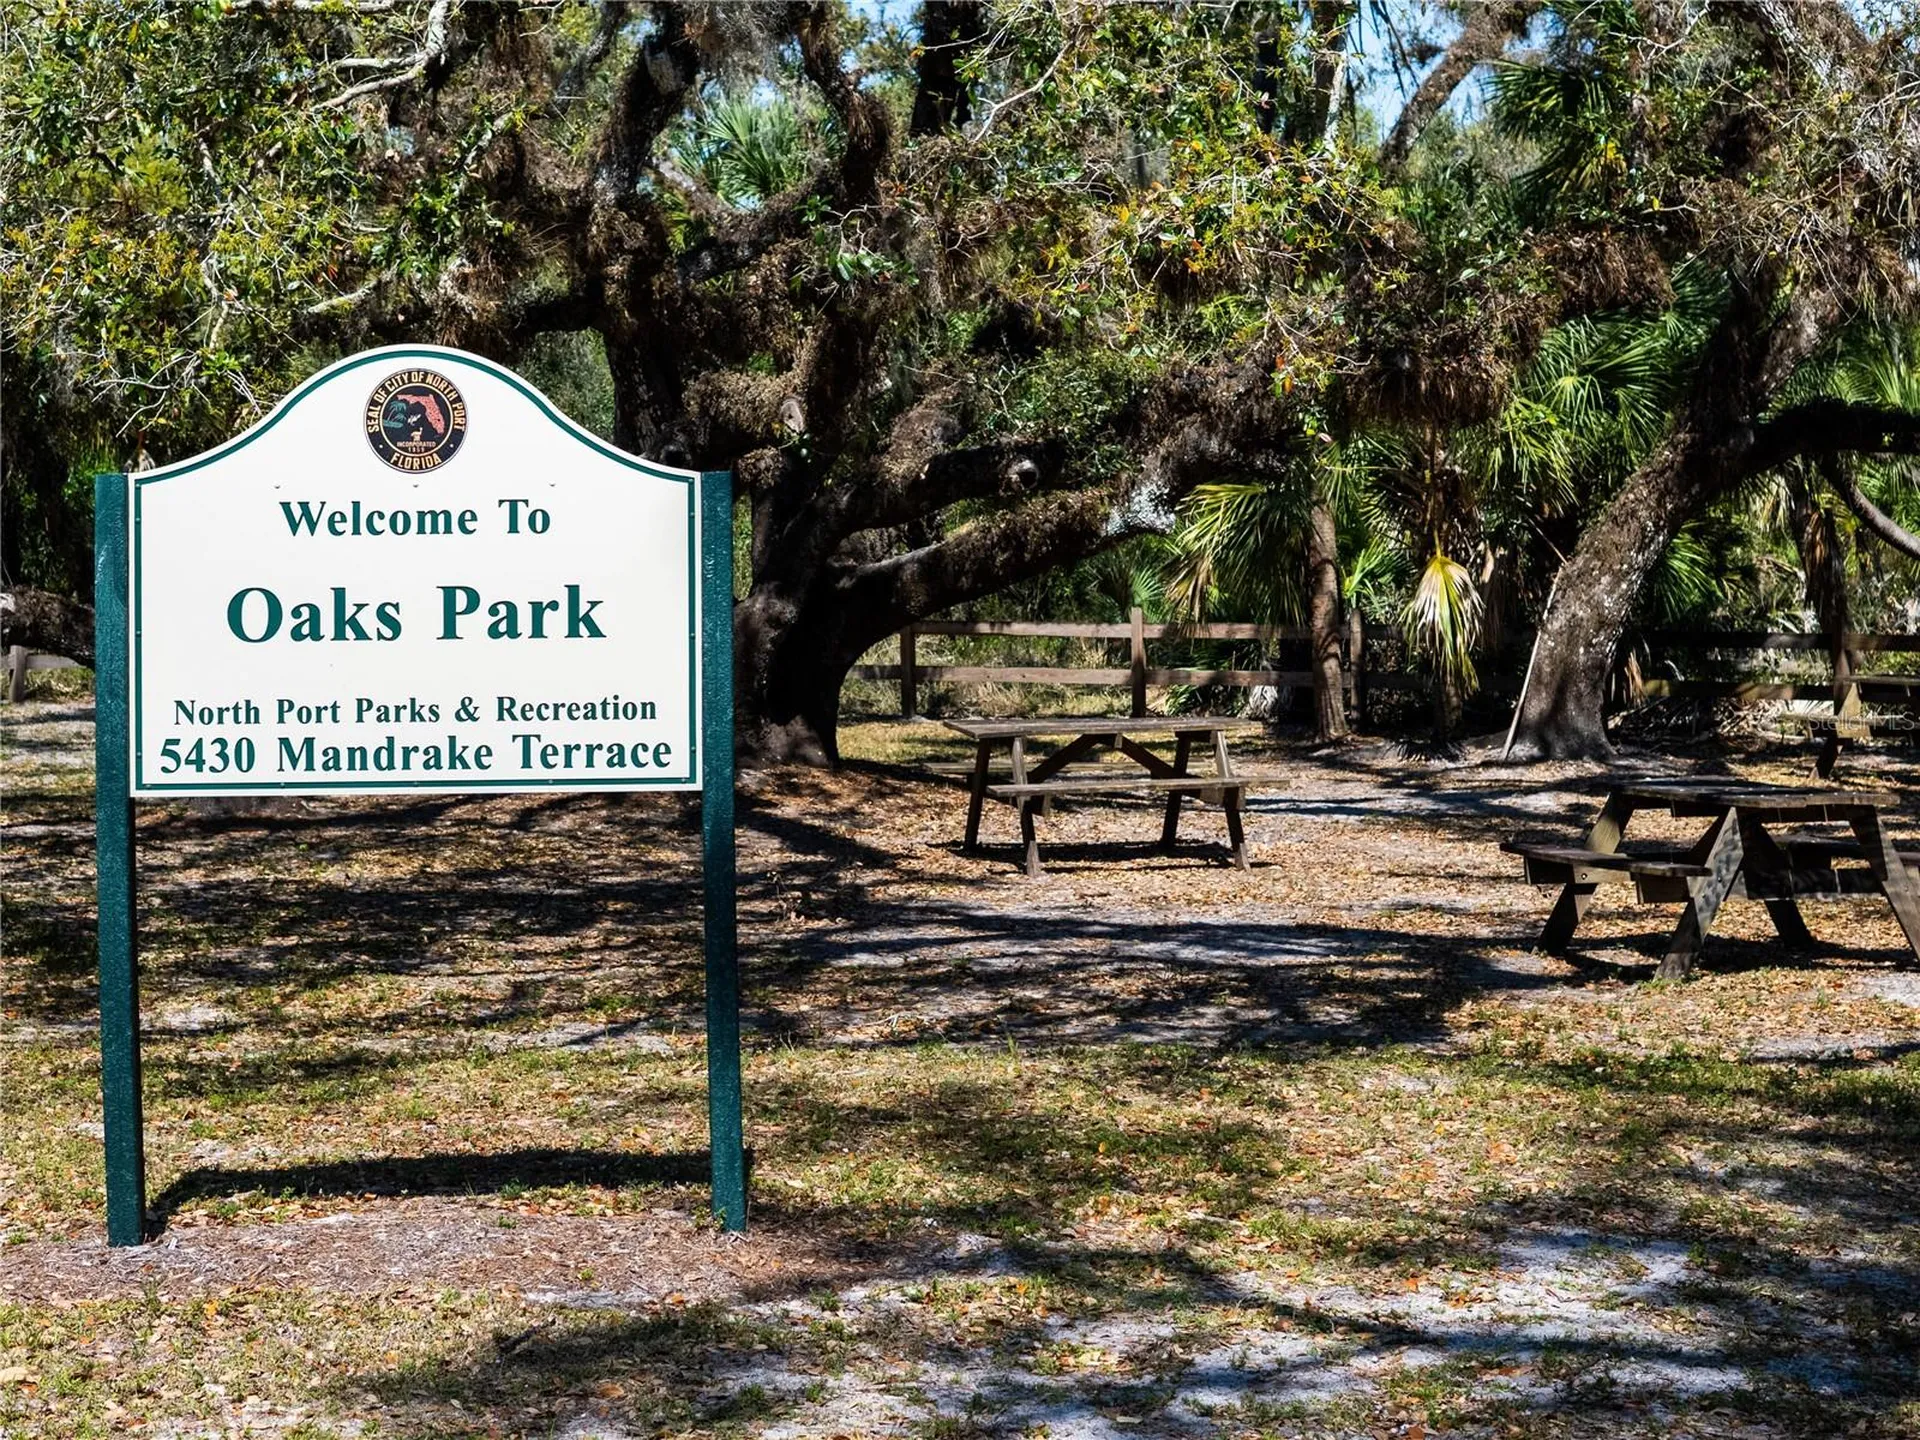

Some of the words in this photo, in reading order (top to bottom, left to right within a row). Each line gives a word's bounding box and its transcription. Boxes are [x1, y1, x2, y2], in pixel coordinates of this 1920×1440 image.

[385, 372, 409, 392] CITY
[411, 371, 425, 382] OF
[426, 373, 458, 401] NORTH
[373, 388, 388, 402] OF
[368, 405, 381, 433] SEAL
[452, 402, 466, 432] PORT
[390, 452, 442, 470] FLORIDA
[279, 501, 478, 537] Welcome
[499, 499, 551, 535] To
[227, 587, 402, 643] Oaks
[436, 585, 607, 641] Park
[173, 699, 260, 726] North
[276, 698, 341, 725] Port
[355, 697, 441, 724] Parks
[454, 696, 481, 723] &
[496, 695, 657, 722] Recreation
[160, 737, 256, 774] 5430
[277, 735, 493, 772] Mandrake
[511, 734, 672, 770] Terrace
